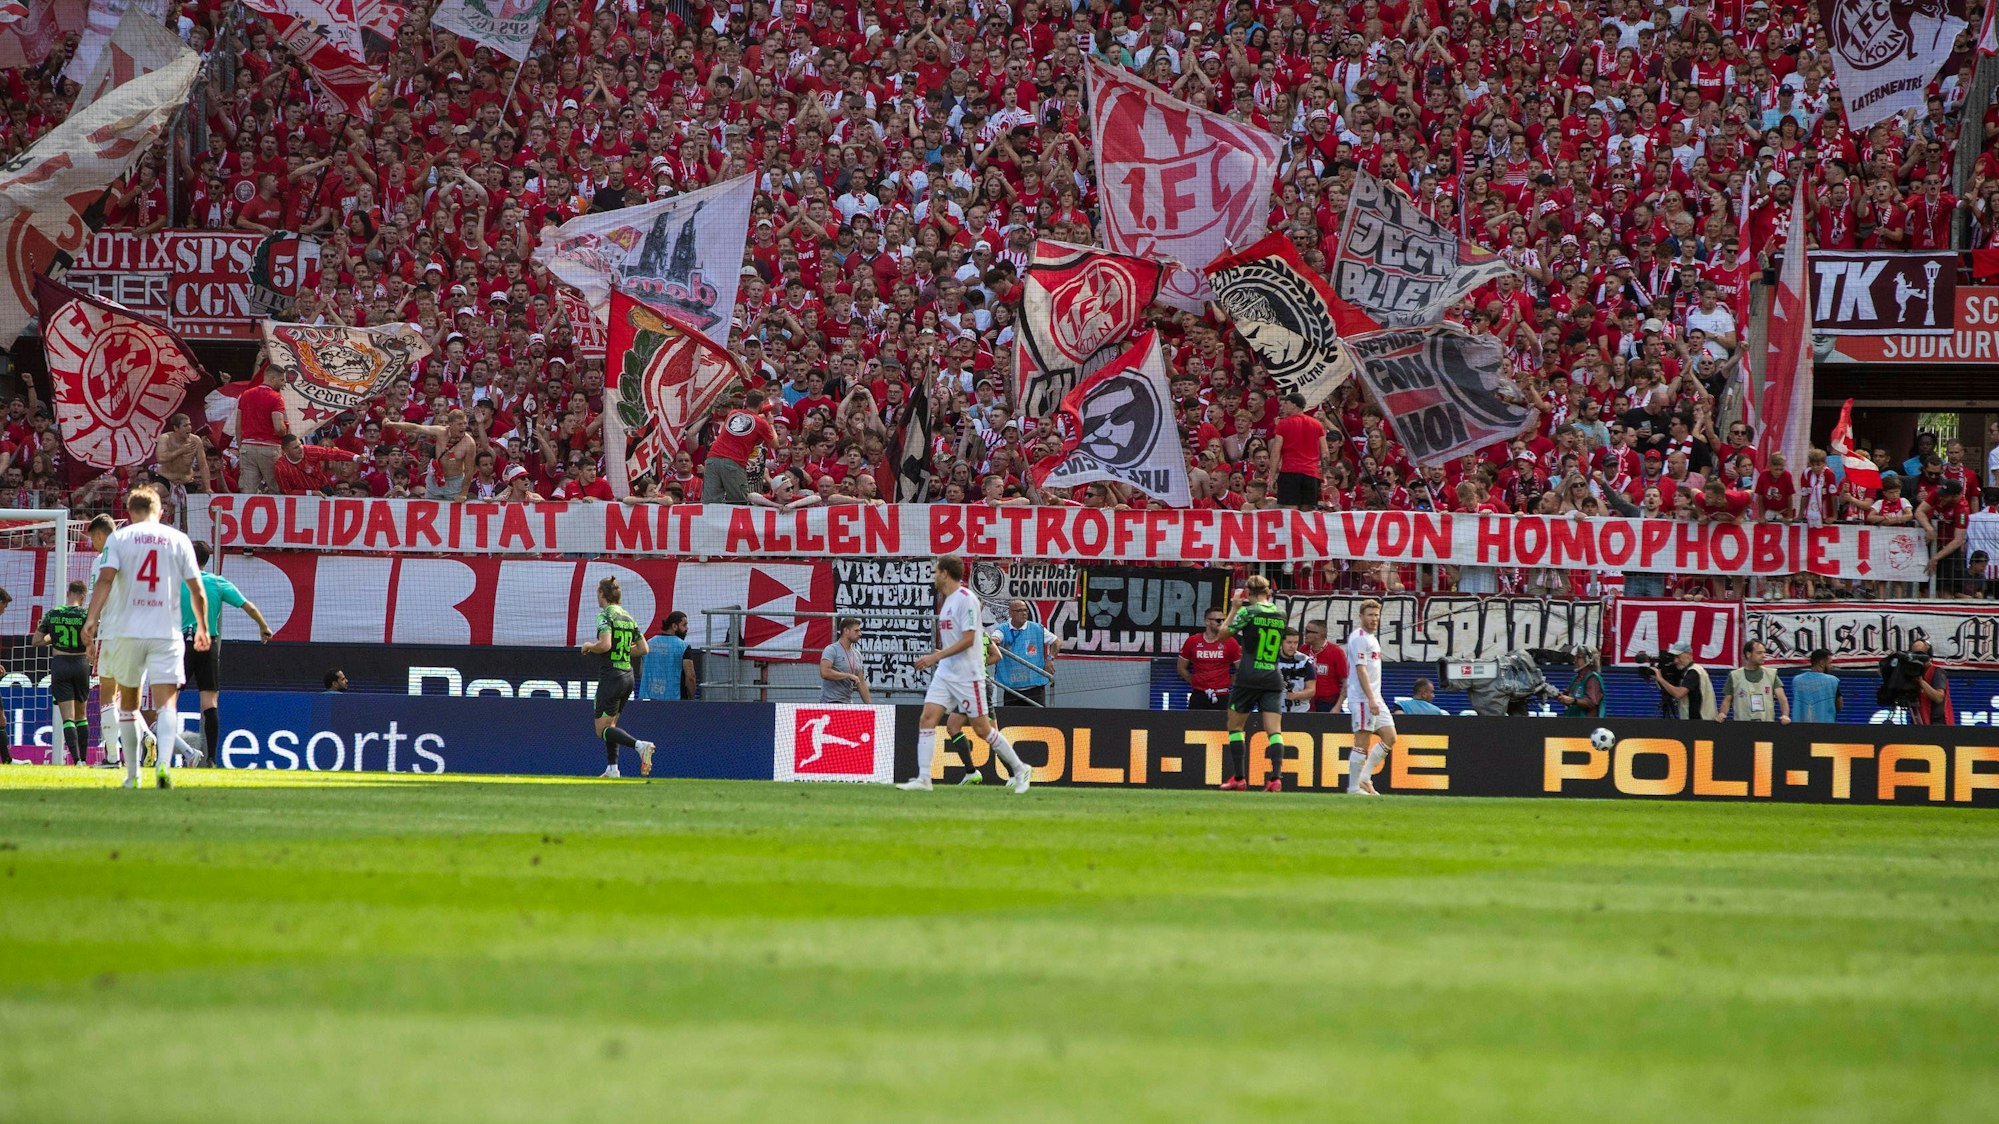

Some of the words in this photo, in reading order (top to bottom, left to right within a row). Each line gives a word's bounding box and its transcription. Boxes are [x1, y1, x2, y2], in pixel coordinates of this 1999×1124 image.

[1865, 29, 1904, 64] KÖLN
[176, 238, 253, 274] SPS
[175, 282, 253, 317] CGN
[1814, 260, 1890, 323] TK
[208, 496, 568, 550] SOLIDARITÄT
[606, 503, 704, 552] MIT
[726, 503, 900, 554] ALLEN
[929, 504, 1329, 561] BETROFFENEN
[1342, 510, 1453, 559] VON
[1477, 513, 1840, 576] HOMOPHOBIE
[136, 549, 160, 593] 4
[54, 625, 79, 648] 31
[1196, 650, 1224, 659] REWE
[1256, 627, 1282, 663] 19
